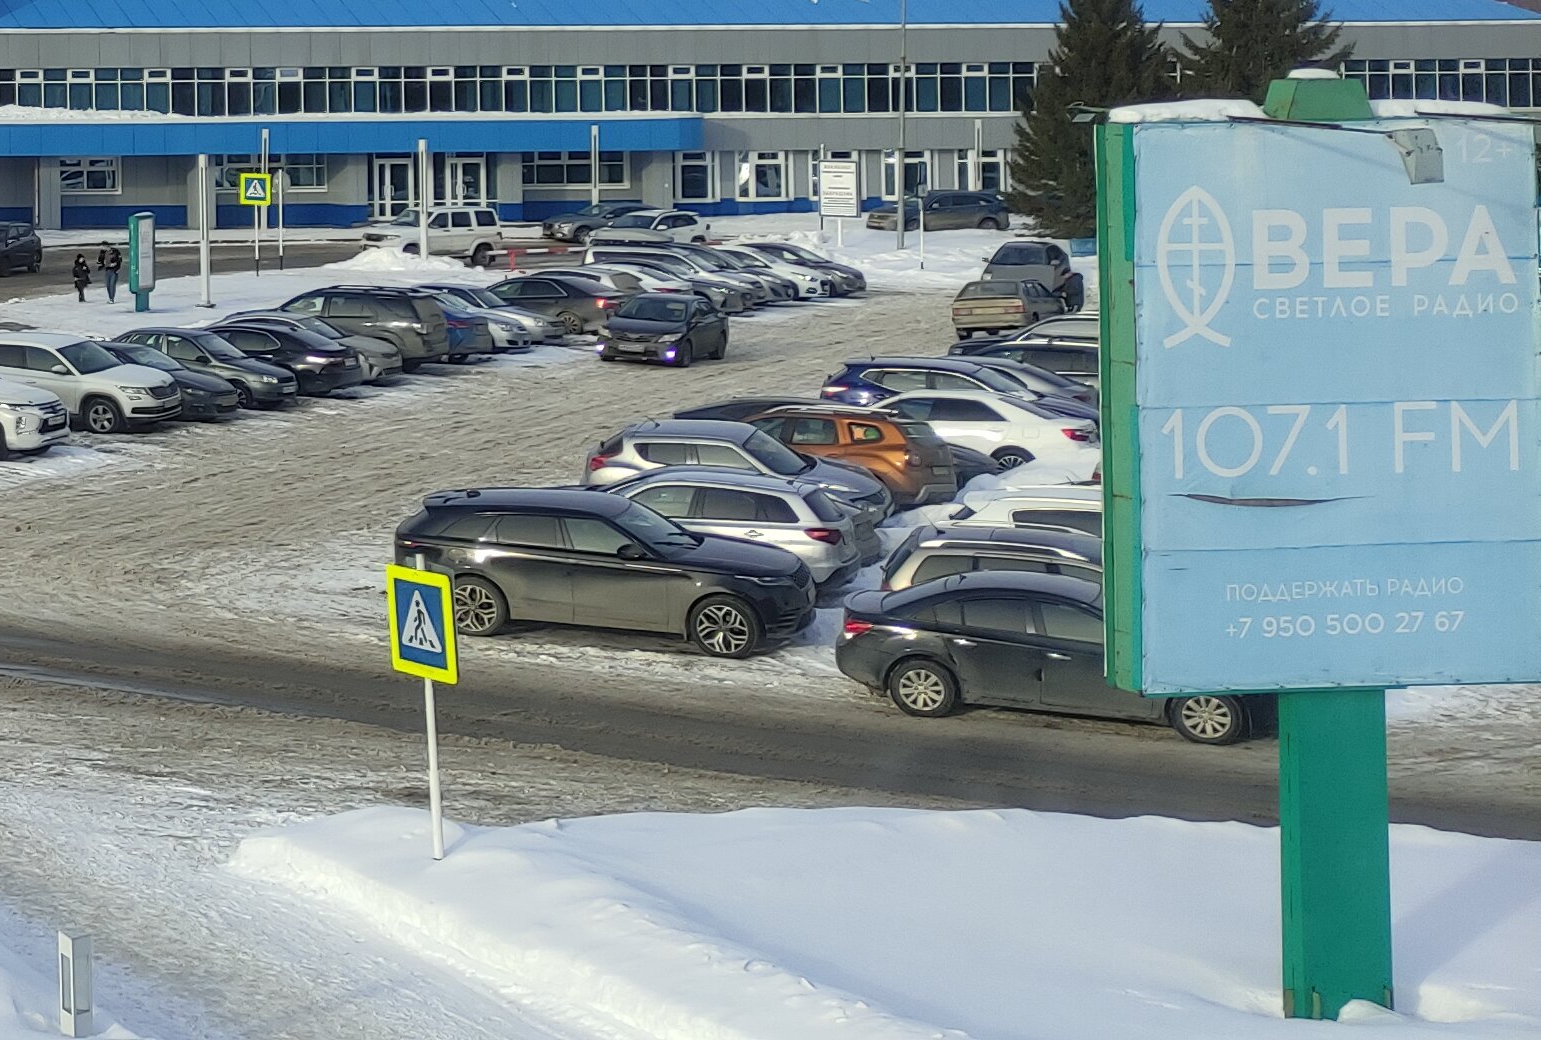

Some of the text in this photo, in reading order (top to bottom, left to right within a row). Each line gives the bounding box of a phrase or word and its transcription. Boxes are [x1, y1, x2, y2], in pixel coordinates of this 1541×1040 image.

[1460, 133, 1513, 164] 12+
[1251, 203, 1518, 290] ВЕРА
[1252, 292, 1519, 320] СВЕТЛОЕ РАДИО
[1161, 398, 1519, 480] 107.1 FM
[1226, 577, 1465, 603] ПОДДЕРЖАТЬ РАДИО
[1225, 610, 1465, 639] +7 950 500 27 67
